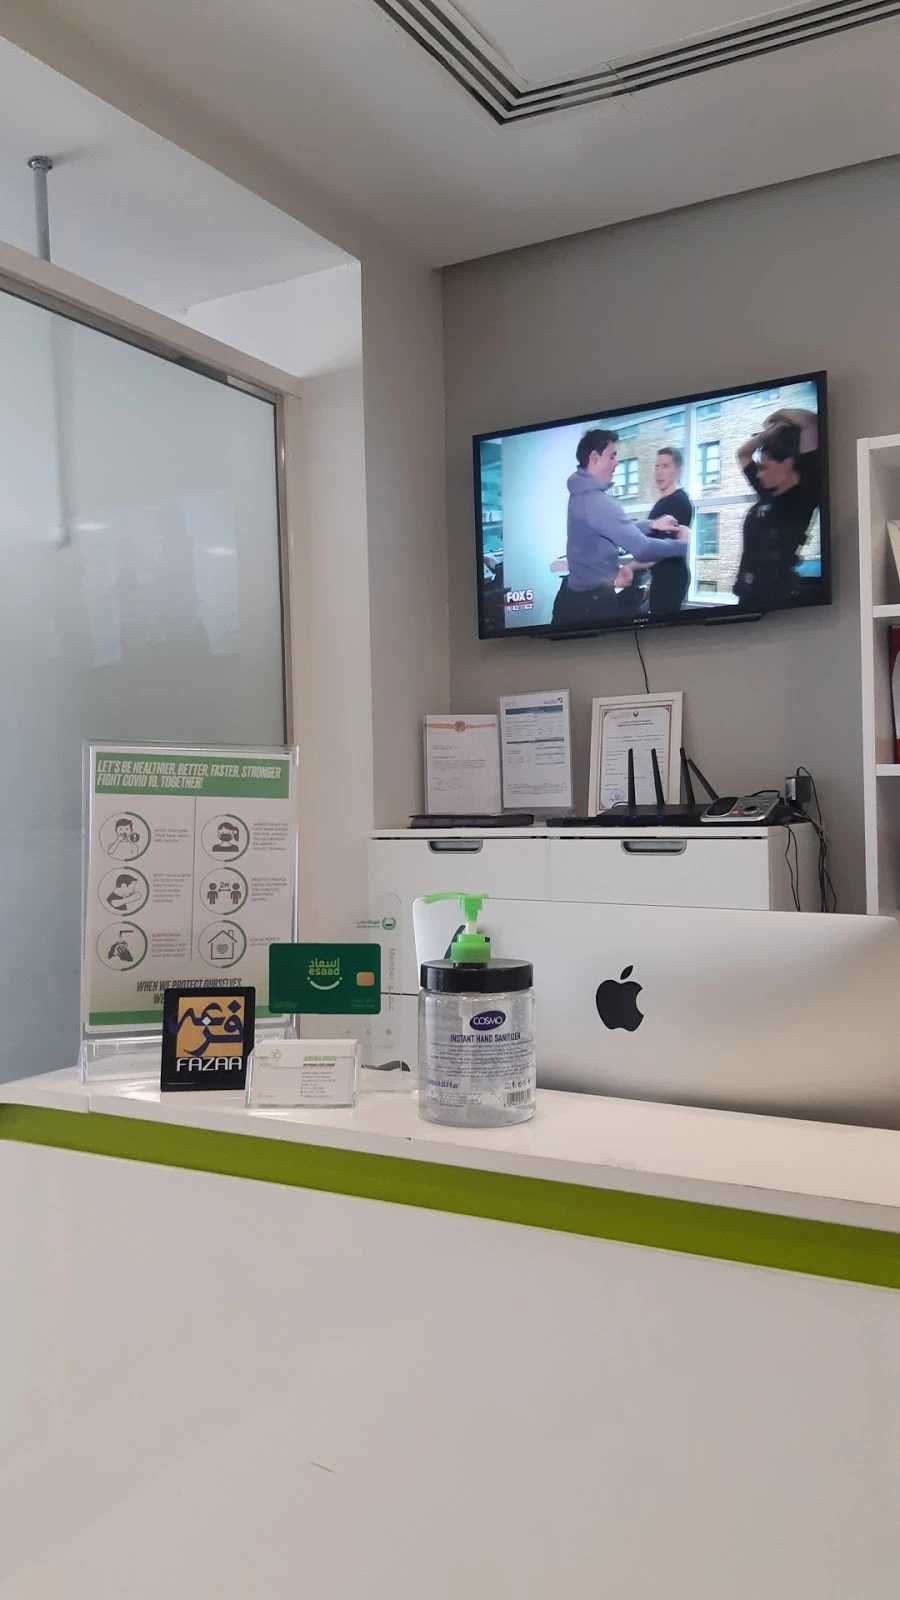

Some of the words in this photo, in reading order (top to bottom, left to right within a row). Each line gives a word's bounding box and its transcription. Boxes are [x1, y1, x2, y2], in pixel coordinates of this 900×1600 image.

[97, 760, 121, 774] LET'S
[121, 761, 132, 774] BE
[132, 762, 176, 776] HEALTHIER,
[177, 763, 209, 777] BETTER,
[210, 764, 240, 778] FASTER,
[241, 766, 282, 780] STRONGER
[97, 774, 121, 787] FIGHT
[122, 775, 147, 788] COVID
[147, 776, 159, 789] 19,
[160, 776, 204, 789] TOGETHER!
[388, 947, 396, 980] Member
[308, 966, 340, 976] esaad
[136, 980, 159, 992] WHEN
[159, 980, 171, 991] WE
[171, 979, 203, 988] PROTECT
[472, 1015, 503, 1026] COSMO
[450, 1034, 474, 1043] INSTANT
[476, 1034, 493, 1043] HAND
[494, 1032, 521, 1043] SANITIZER
[176, 1056, 243, 1072] FAZAA
